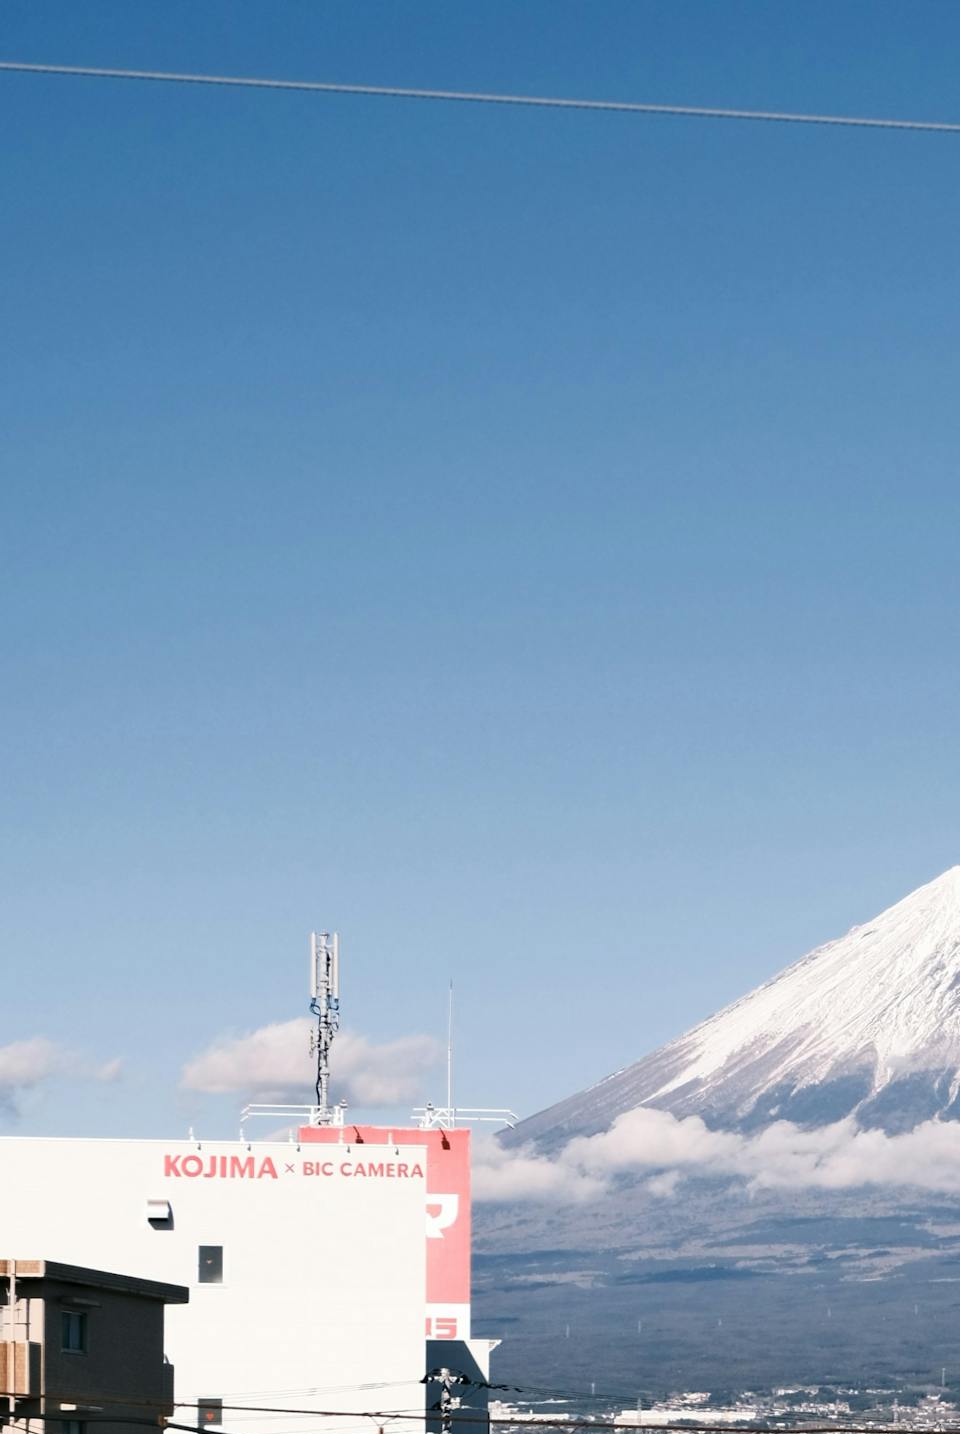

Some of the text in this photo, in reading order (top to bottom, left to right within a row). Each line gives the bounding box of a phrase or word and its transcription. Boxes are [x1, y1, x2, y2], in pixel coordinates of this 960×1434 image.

[164, 1154, 279, 1179] KOJIMA
[303, 1162, 334, 1177] BIC
[340, 1162, 424, 1178] CAMERA
